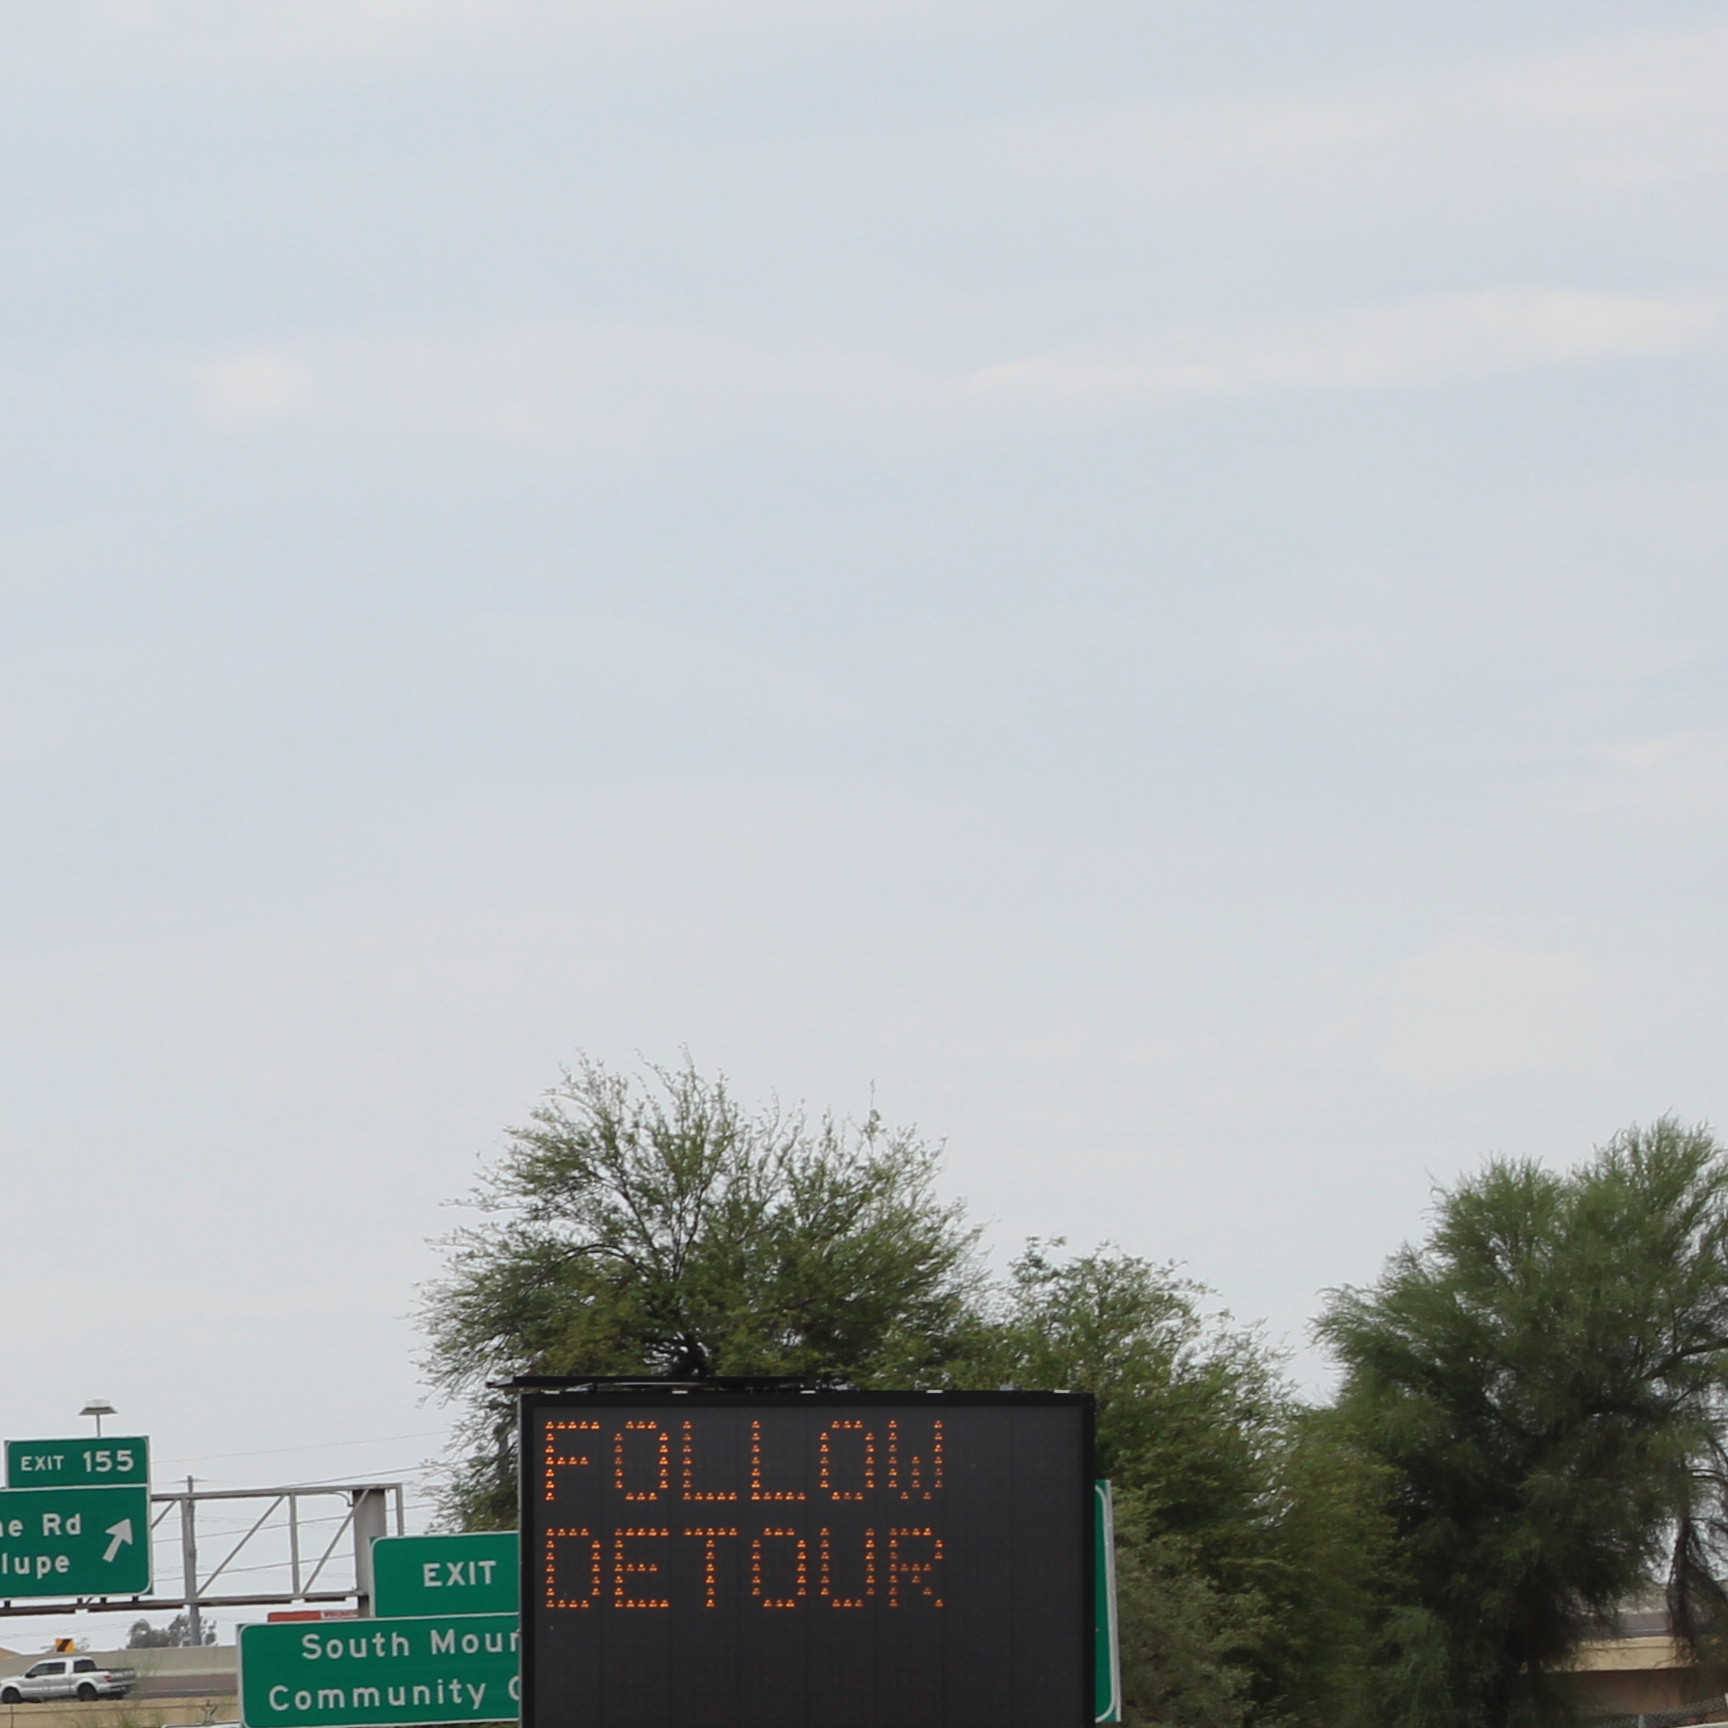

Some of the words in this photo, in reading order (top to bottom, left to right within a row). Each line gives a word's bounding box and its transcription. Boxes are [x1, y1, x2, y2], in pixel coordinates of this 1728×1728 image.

[21, 1455, 64, 1471] EXIT
[83, 1450, 135, 1472] 155
[545, 1419, 943, 1500] FOLLOW
[43, 1513, 81, 1536] Rd
[423, 1560, 496, 1587] EXIT
[545, 1527, 943, 1608] DETOUR
[302, 1631, 409, 1659] South
[269, 1678, 486, 1711] Community
